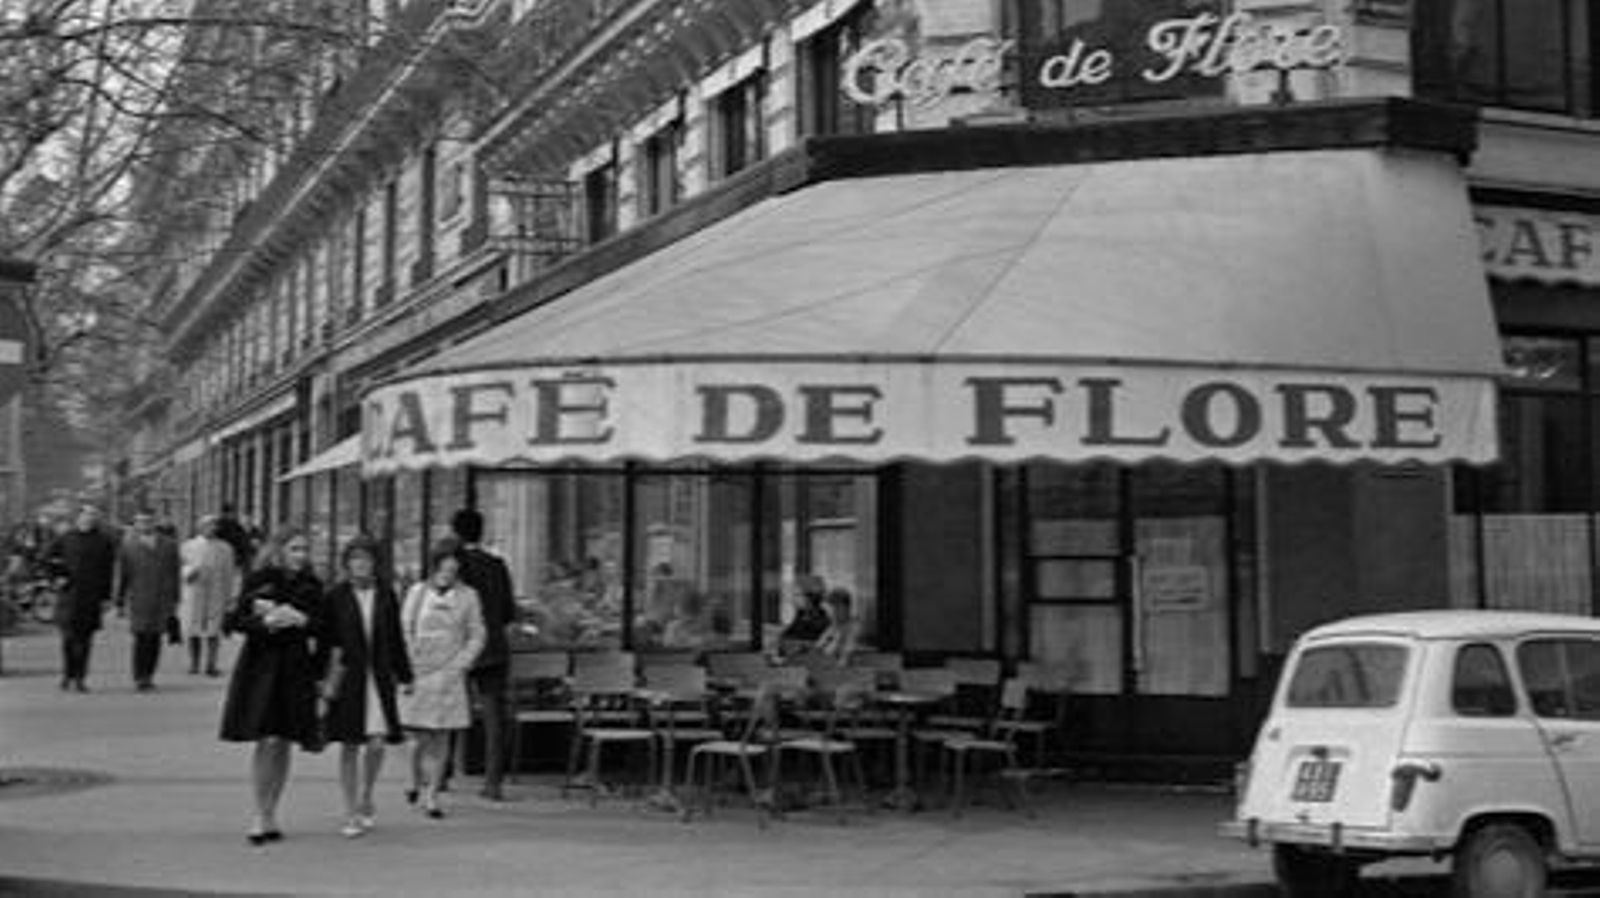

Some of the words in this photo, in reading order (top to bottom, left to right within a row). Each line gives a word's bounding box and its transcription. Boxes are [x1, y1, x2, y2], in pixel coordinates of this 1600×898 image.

[1040, 38, 1112, 88] de
[1142, 11, 1346, 82] Flore
[693, 383, 884, 446] DE
[964, 376, 1442, 449] FLORE
